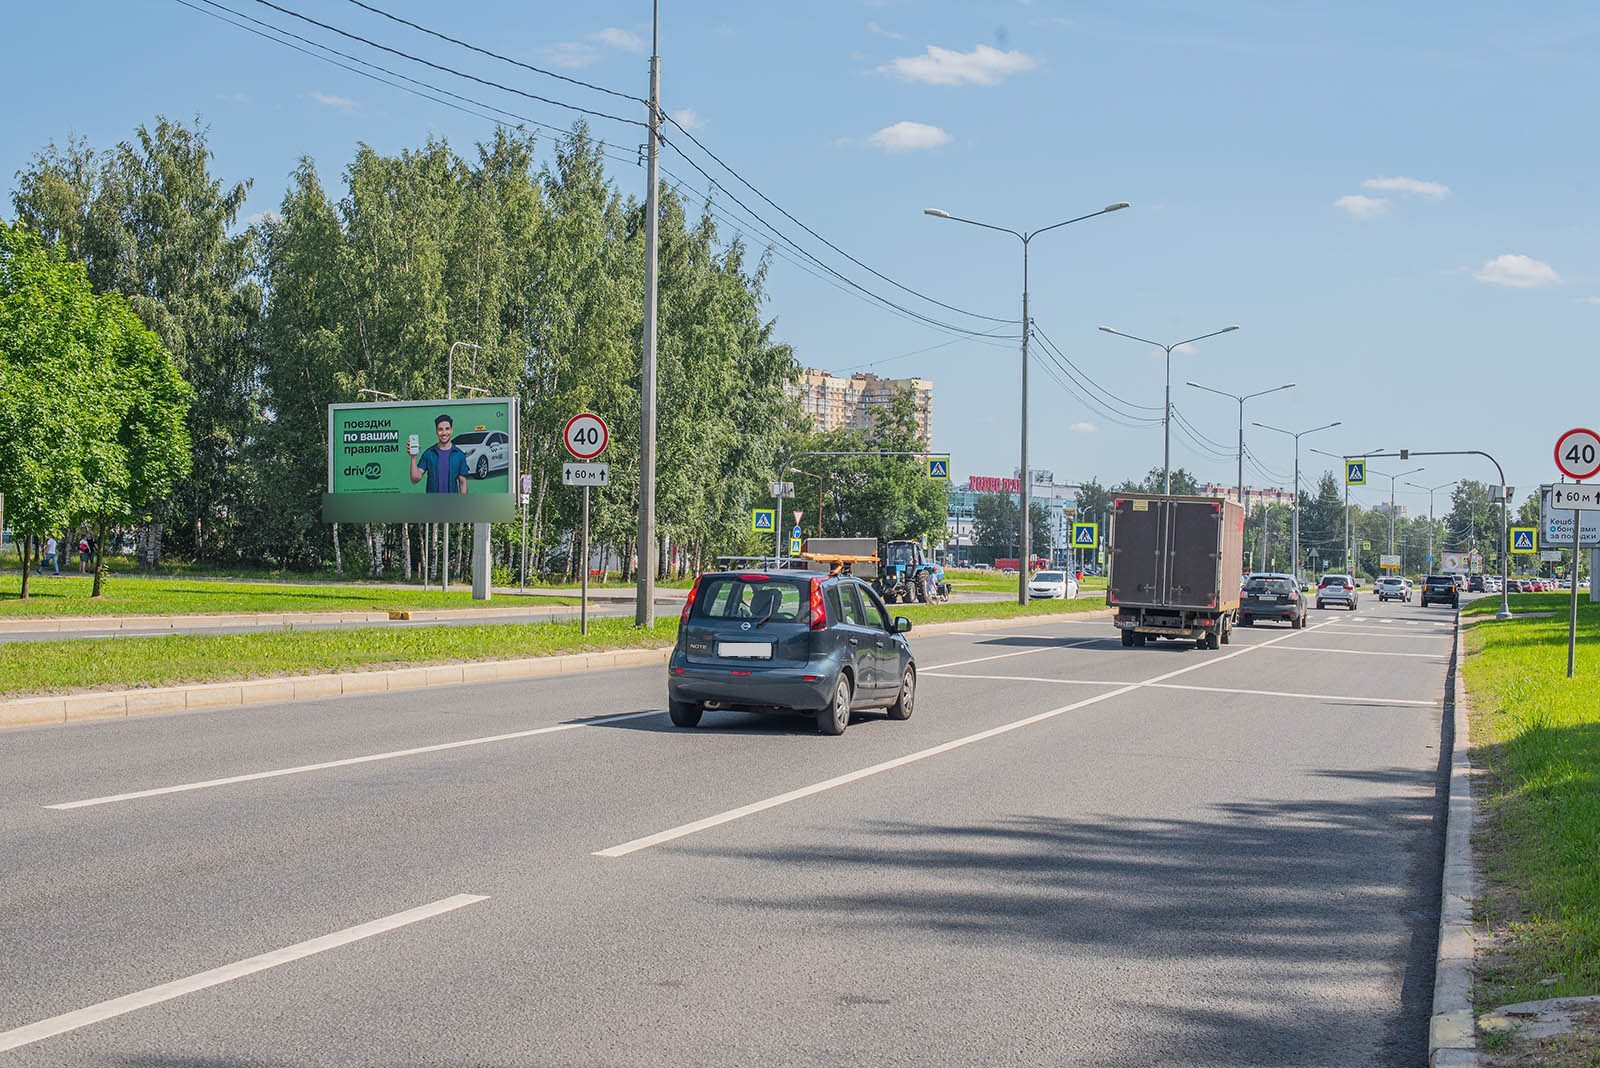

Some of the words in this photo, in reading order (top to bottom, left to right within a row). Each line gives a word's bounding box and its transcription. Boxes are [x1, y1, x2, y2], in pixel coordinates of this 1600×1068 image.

[344, 419, 391, 429] поездки
[344, 433, 358, 441] по
[360, 431, 398, 441] вашим
[573, 427, 598, 445] 40
[344, 444, 399, 457] правилам
[1565, 444, 1595, 464] 40
[575, 469, 587, 479] 60
[1566, 492, 1580, 502] 60
